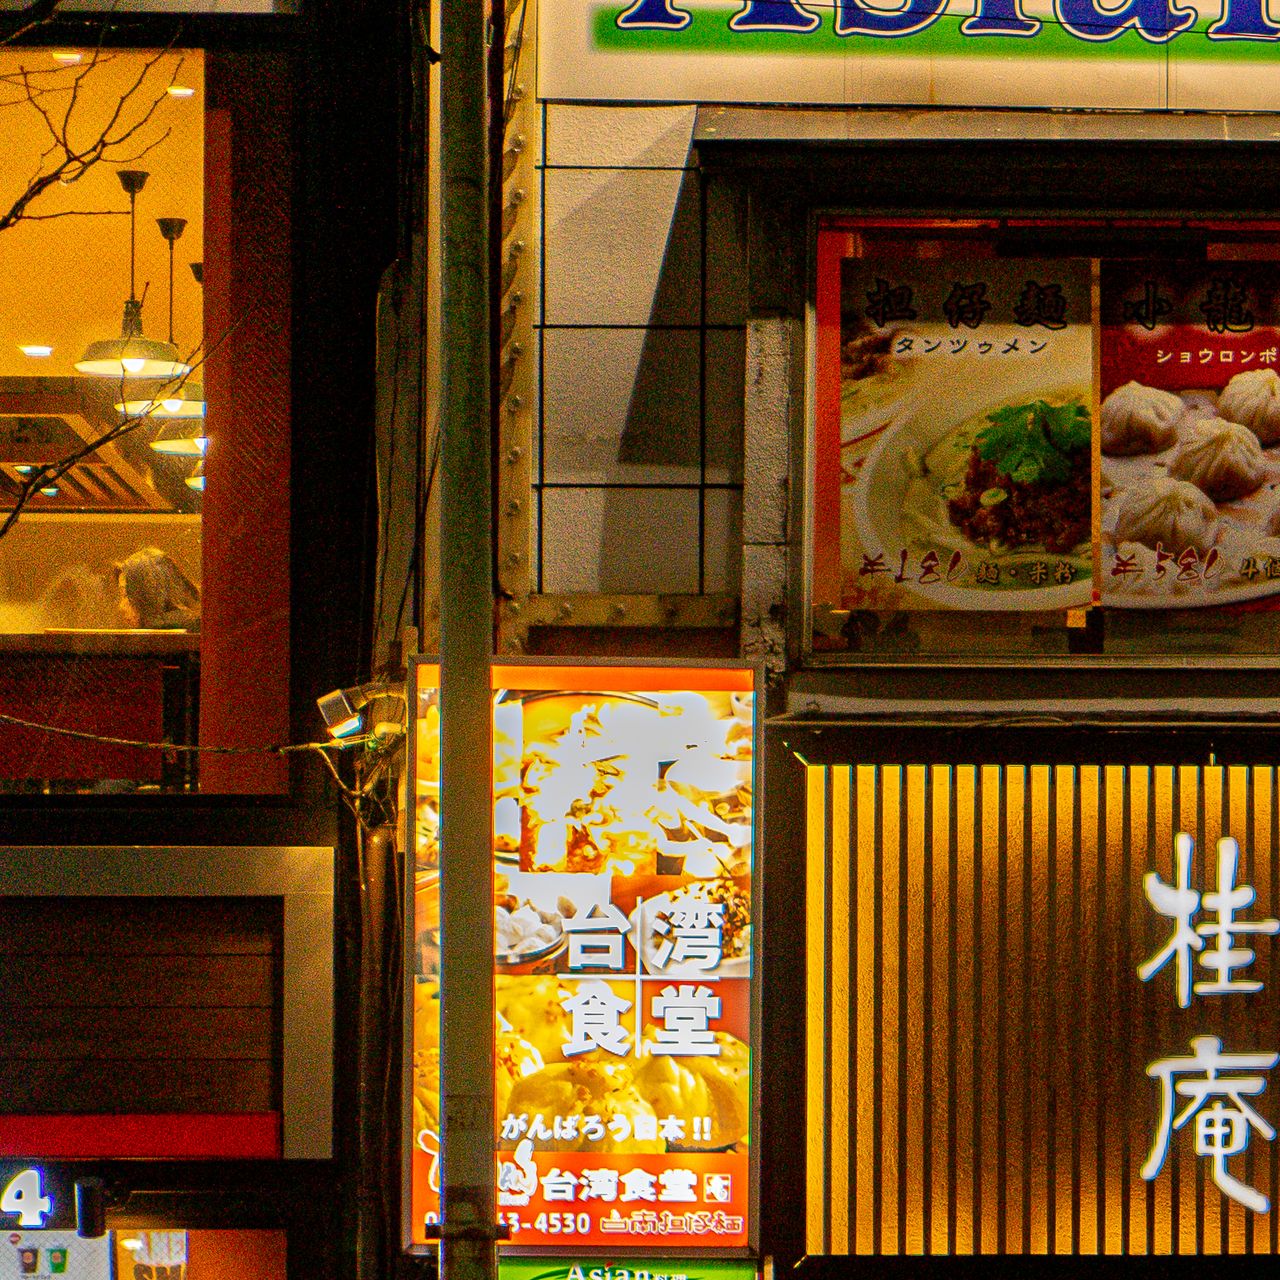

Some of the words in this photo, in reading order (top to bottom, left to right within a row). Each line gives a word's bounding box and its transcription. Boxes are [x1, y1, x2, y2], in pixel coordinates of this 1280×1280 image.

[561, 902, 727, 971] 台湾
[560, 980, 722, 1057] 食堂
[0, 1168, 53, 1227] 4
[541, 1168, 699, 1203] 台湾食堂
